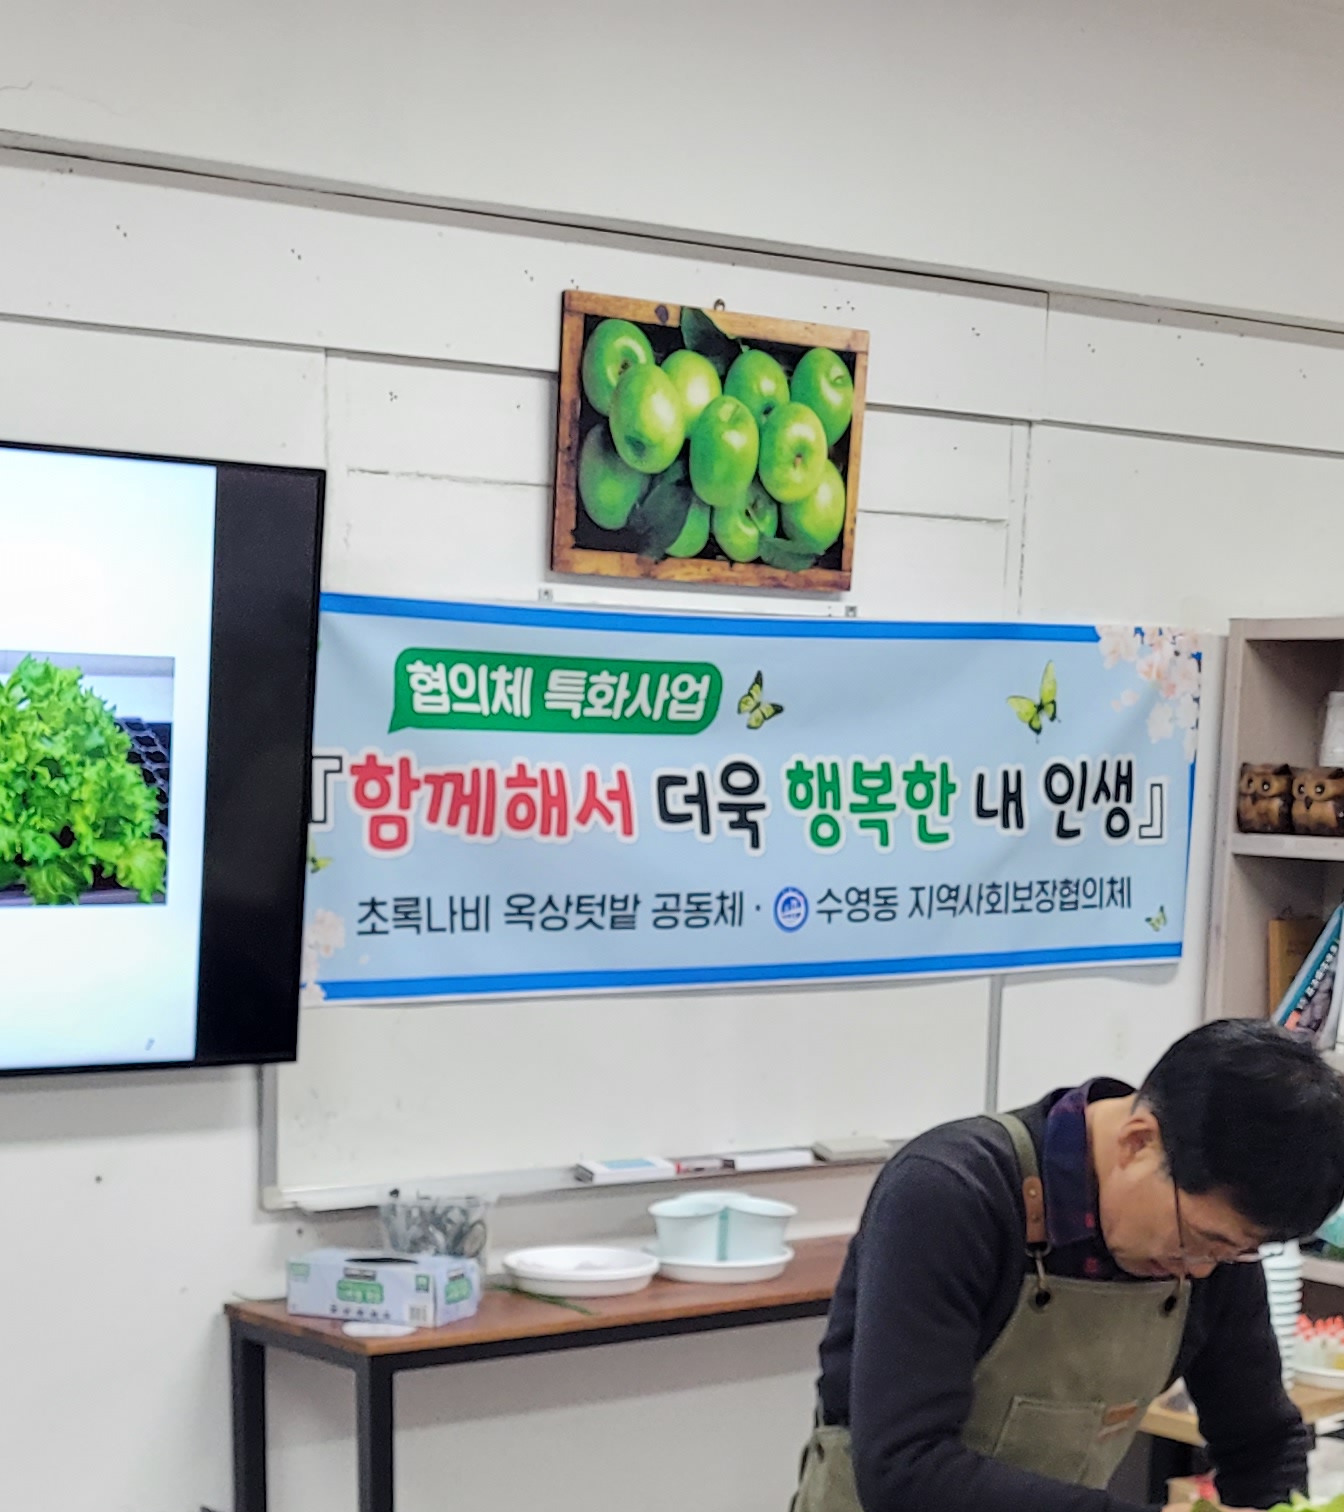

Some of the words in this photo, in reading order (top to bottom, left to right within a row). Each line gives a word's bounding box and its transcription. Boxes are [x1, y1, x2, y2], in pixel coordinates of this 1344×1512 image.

[406, 659, 534, 719] 협의체
[543, 668, 712, 722] 특화사업
[656, 761, 766, 850] 더욱
[786, 760, 956, 847] 행복한
[976, 769, 1024, 829] 내
[356, 894, 491, 936] 초록나비
[503, 892, 641, 932] 옥상텃밭
[816, 886, 899, 925] 수영동
[908, 876, 1133, 921] 지역사회보장협의체
